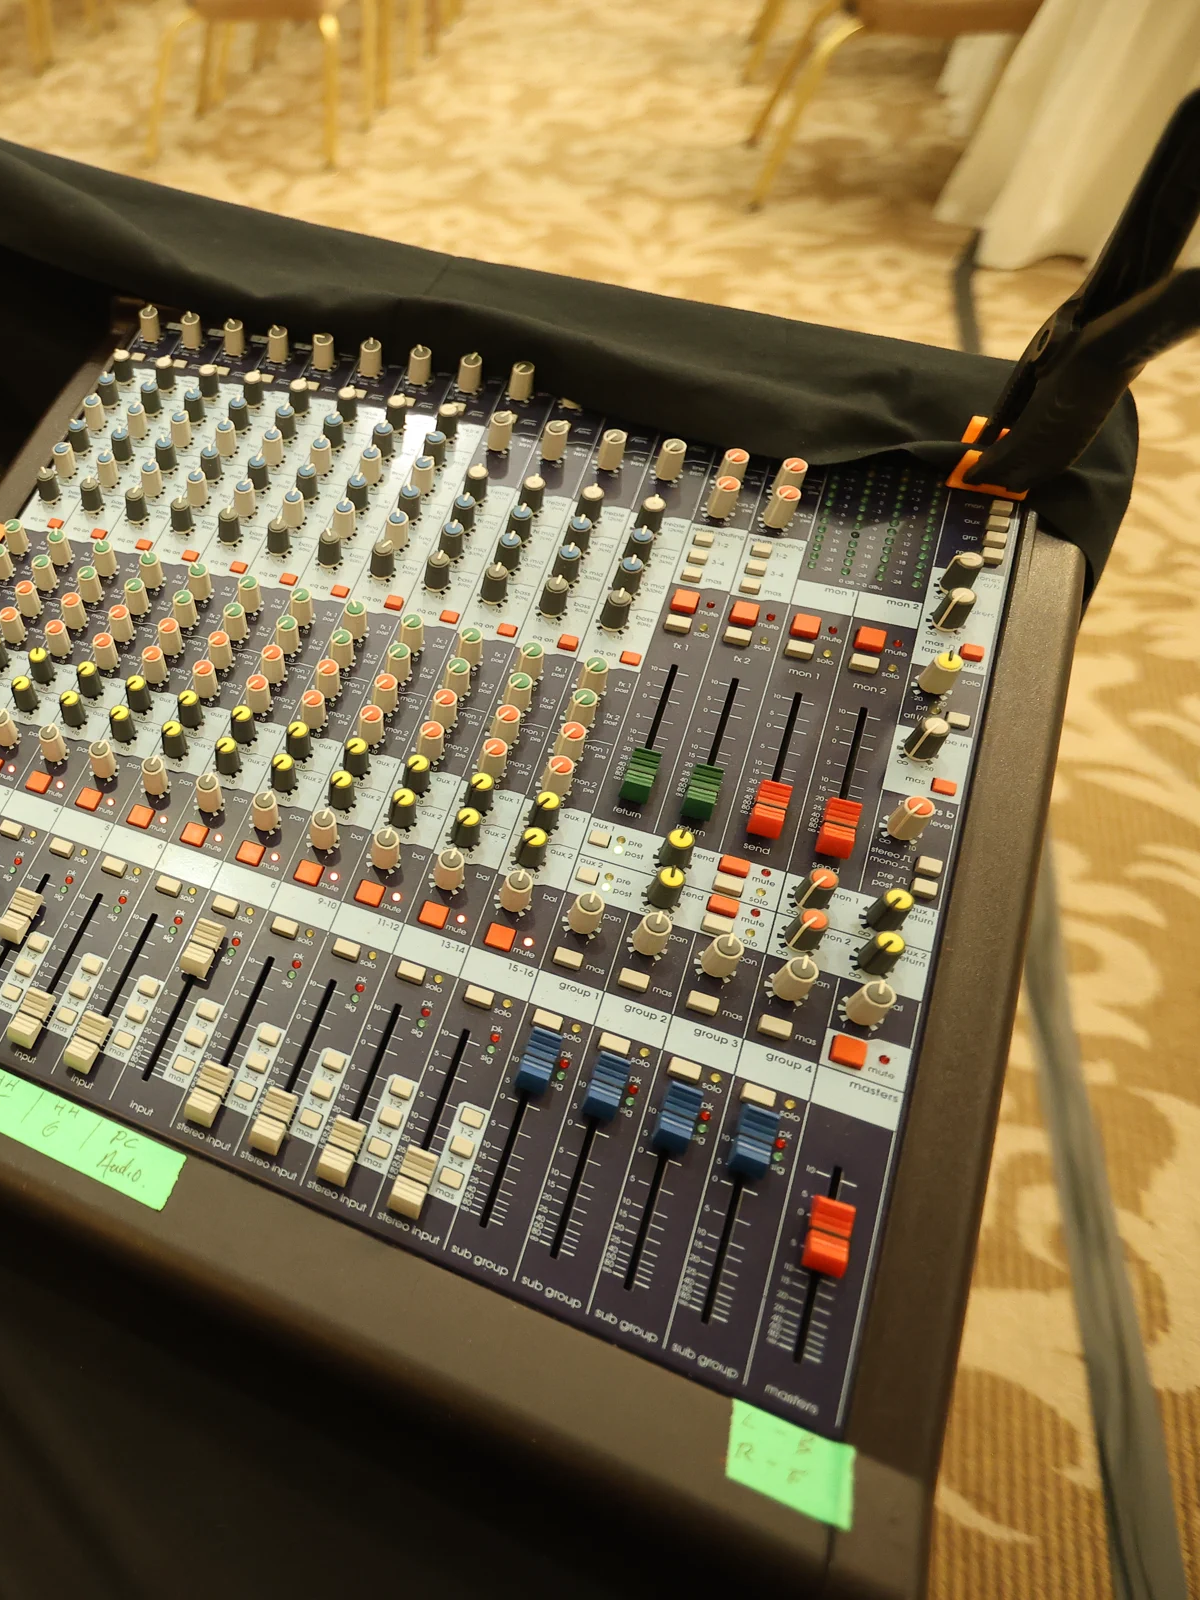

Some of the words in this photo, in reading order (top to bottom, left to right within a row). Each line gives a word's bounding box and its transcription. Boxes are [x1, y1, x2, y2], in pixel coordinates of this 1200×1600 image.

[887, 599, 911, 609] mon
[698, 609, 719, 619] mute
[758, 621, 780, 631] mute
[693, 630, 710, 639] solo
[820, 634, 842, 645] mute
[673, 642, 683, 651] fx
[753, 644, 771, 652] solo
[925, 639, 944, 648] mas
[885, 648, 908, 658] mute
[733, 655, 743, 664] fx
[744, 657, 751, 665] 2
[816, 657, 835, 666] solo
[788, 668, 813, 679] mon
[882, 671, 900, 680] solo
[853, 682, 878, 693] mon
[879, 687, 887, 695] 2
[961, 679, 981, 688] solo
[585, 744, 604, 752] mon
[905, 776, 926, 786] mas
[4, 789, 10, 797] 3
[233, 795, 248, 805] pan
[612, 805, 642, 819] return
[592, 821, 610, 831] aux
[929, 820, 953, 831] level
[628, 840, 643, 849] pre
[743, 842, 771, 855] send
[412, 852, 426, 861] bal
[624, 850, 645, 861] post
[693, 852, 715, 863] send
[871, 846, 901, 860] stereo
[580, 857, 596, 866] aux
[869, 855, 899, 868] mono
[476, 872, 490, 882] bal
[616, 877, 631, 886] pre
[877, 871, 895, 882] pre
[613, 887, 632, 898] post
[681, 889, 704, 901] send
[318, 897, 337, 909] 9-10
[381, 902, 402, 914] mute
[377, 918, 400, 931] 11-12
[741, 915, 765, 928] mute
[441, 940, 465, 954] 13-14
[513, 946, 535, 959] mute
[508, 963, 534, 978] 15-16
[559, 982, 591, 998] group
[652, 986, 673, 998] mas
[624, 1004, 657, 1021] group
[660, 1015, 667, 1024] 2
[490, 1025, 504, 1034] pk
[563, 1032, 582, 1043] solo
[693, 1027, 729, 1045] group
[731, 1039, 739, 1048] 3
[795, 1033, 817, 1046] mas
[14, 1049, 37, 1065] input
[765, 1052, 802, 1071] group
[805, 1065, 813, 1074] 4
[71, 1074, 94, 1090] input
[550, 1081, 564, 1091] sig
[629, 1076, 642, 1085] pk
[702, 1081, 722, 1095] solo
[849, 1080, 899, 1103] masters
[129, 1100, 153, 1117] input
[42, 1121, 60, 1137] 6
[110, 1130, 139, 1149] PC
[176, 1121, 205, 1140] stereo
[206, 1134, 232, 1151] input
[240, 1150, 270, 1169] stereo
[272, 1163, 298, 1181] input
[307, 1180, 338, 1200] stereo
[340, 1193, 368, 1213] input
[377, 1211, 410, 1232] stereo
[411, 1227, 441, 1245] input
[451, 1244, 472, 1260] sub
[473, 1255, 509, 1276] group
[521, 1275, 543, 1291] sub
[544, 1287, 582, 1309] group
[595, 1308, 618, 1325] sub
[619, 1319, 659, 1344] group
[671, 1343, 697, 1360] sub
[697, 1354, 739, 1380] group
[764, 1383, 819, 1416] masters
[734, 1442, 754, 1462] R
